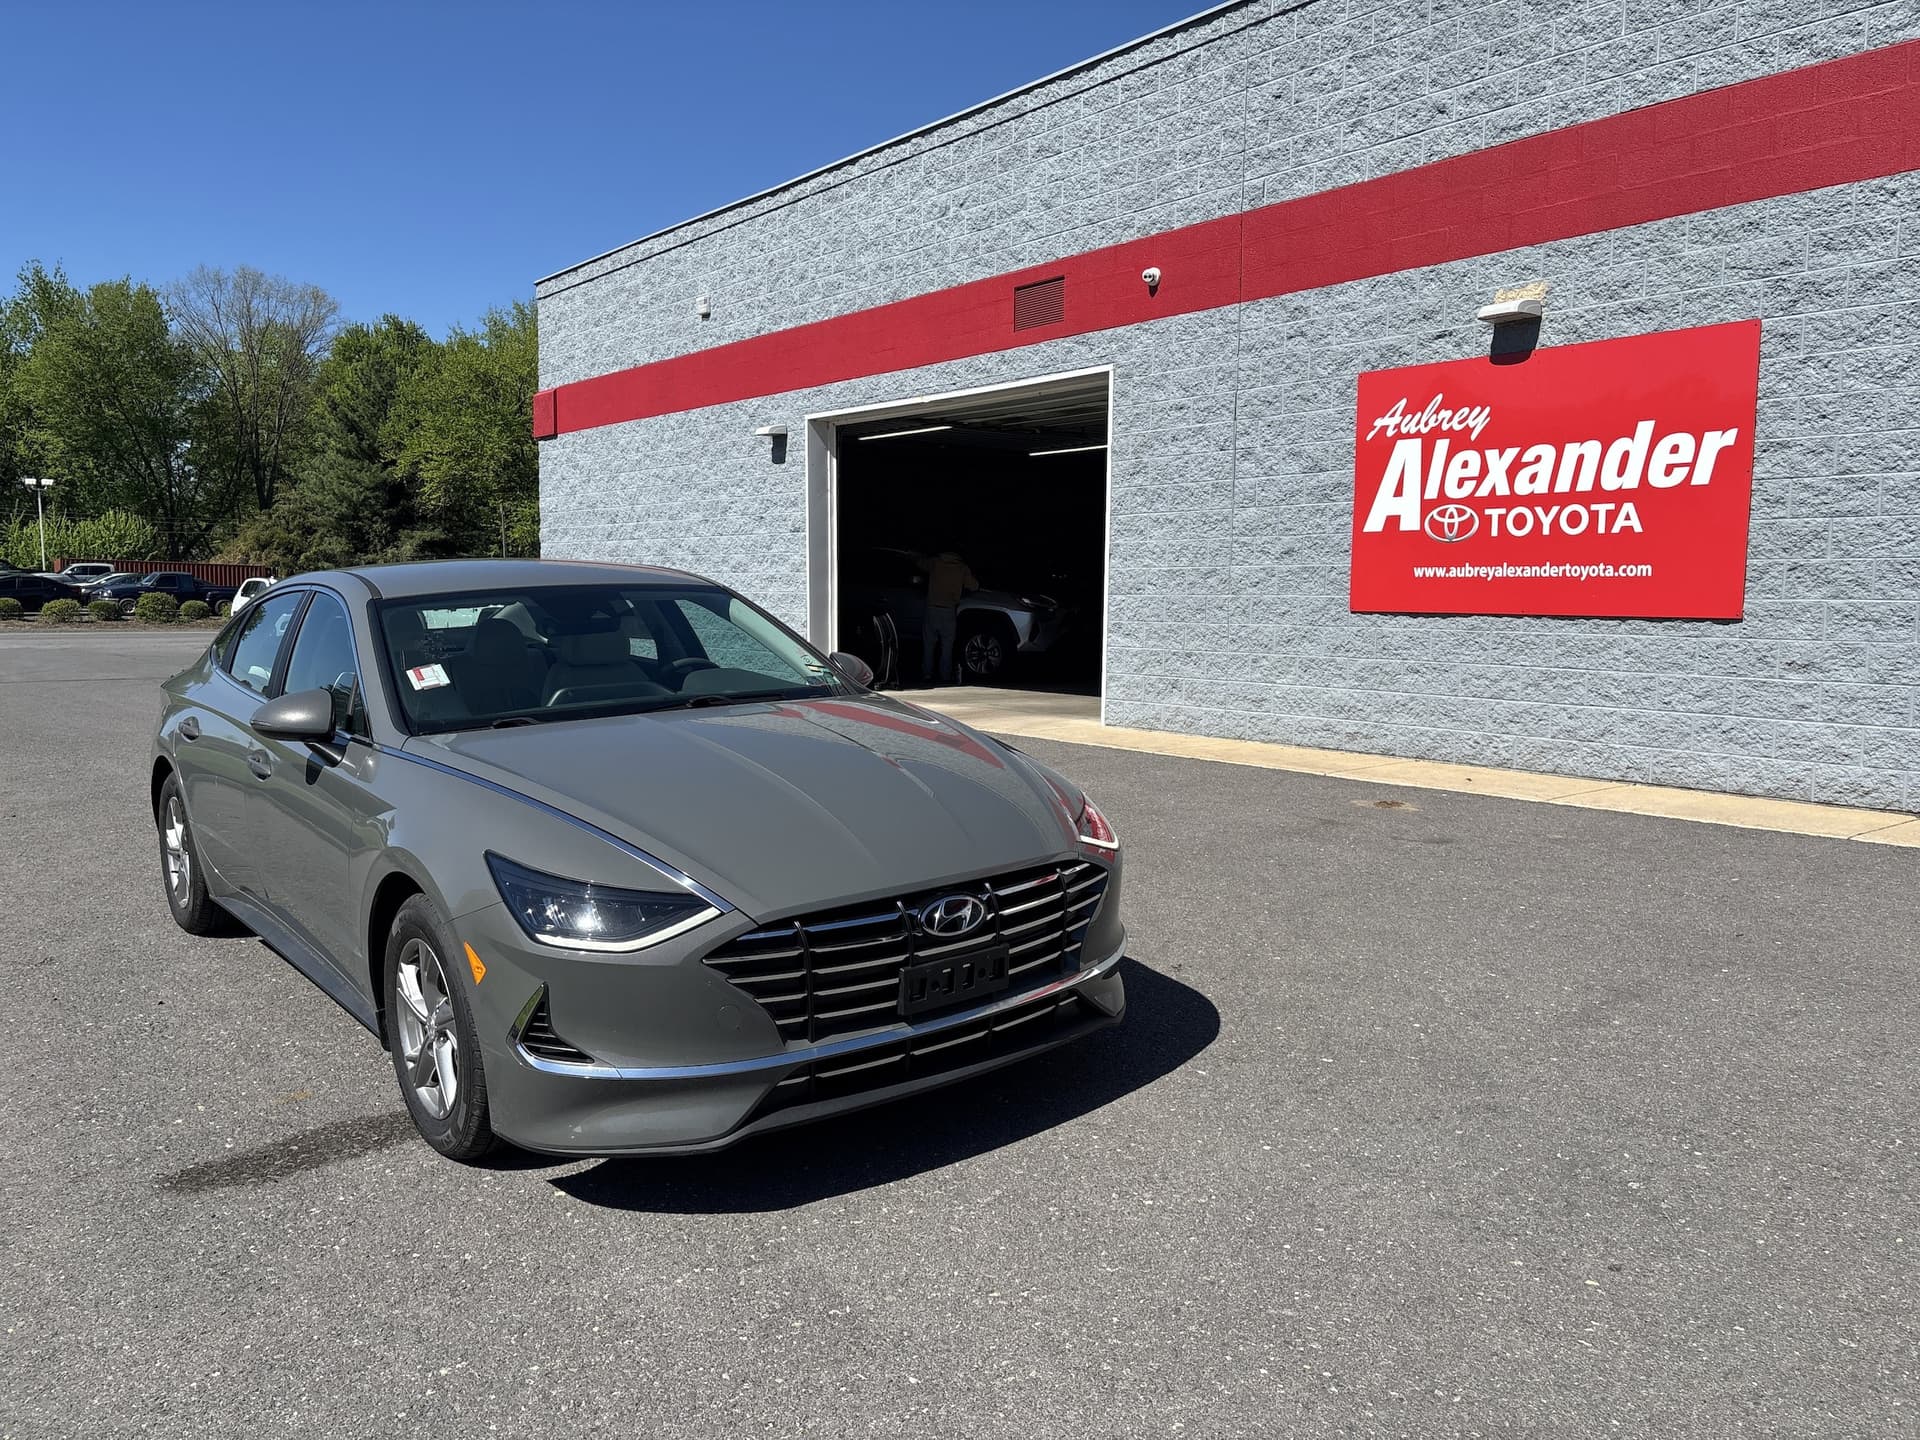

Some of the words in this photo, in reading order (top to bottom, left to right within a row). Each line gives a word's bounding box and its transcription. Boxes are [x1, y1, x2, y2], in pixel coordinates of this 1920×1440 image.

[1366, 393, 1492, 441] Aubrey
[1363, 420, 1738, 533] Alexander
[1484, 502, 1643, 537] TOYOTA
[1413, 561, 1653, 582] www.aubreyalexandertoyota.com
